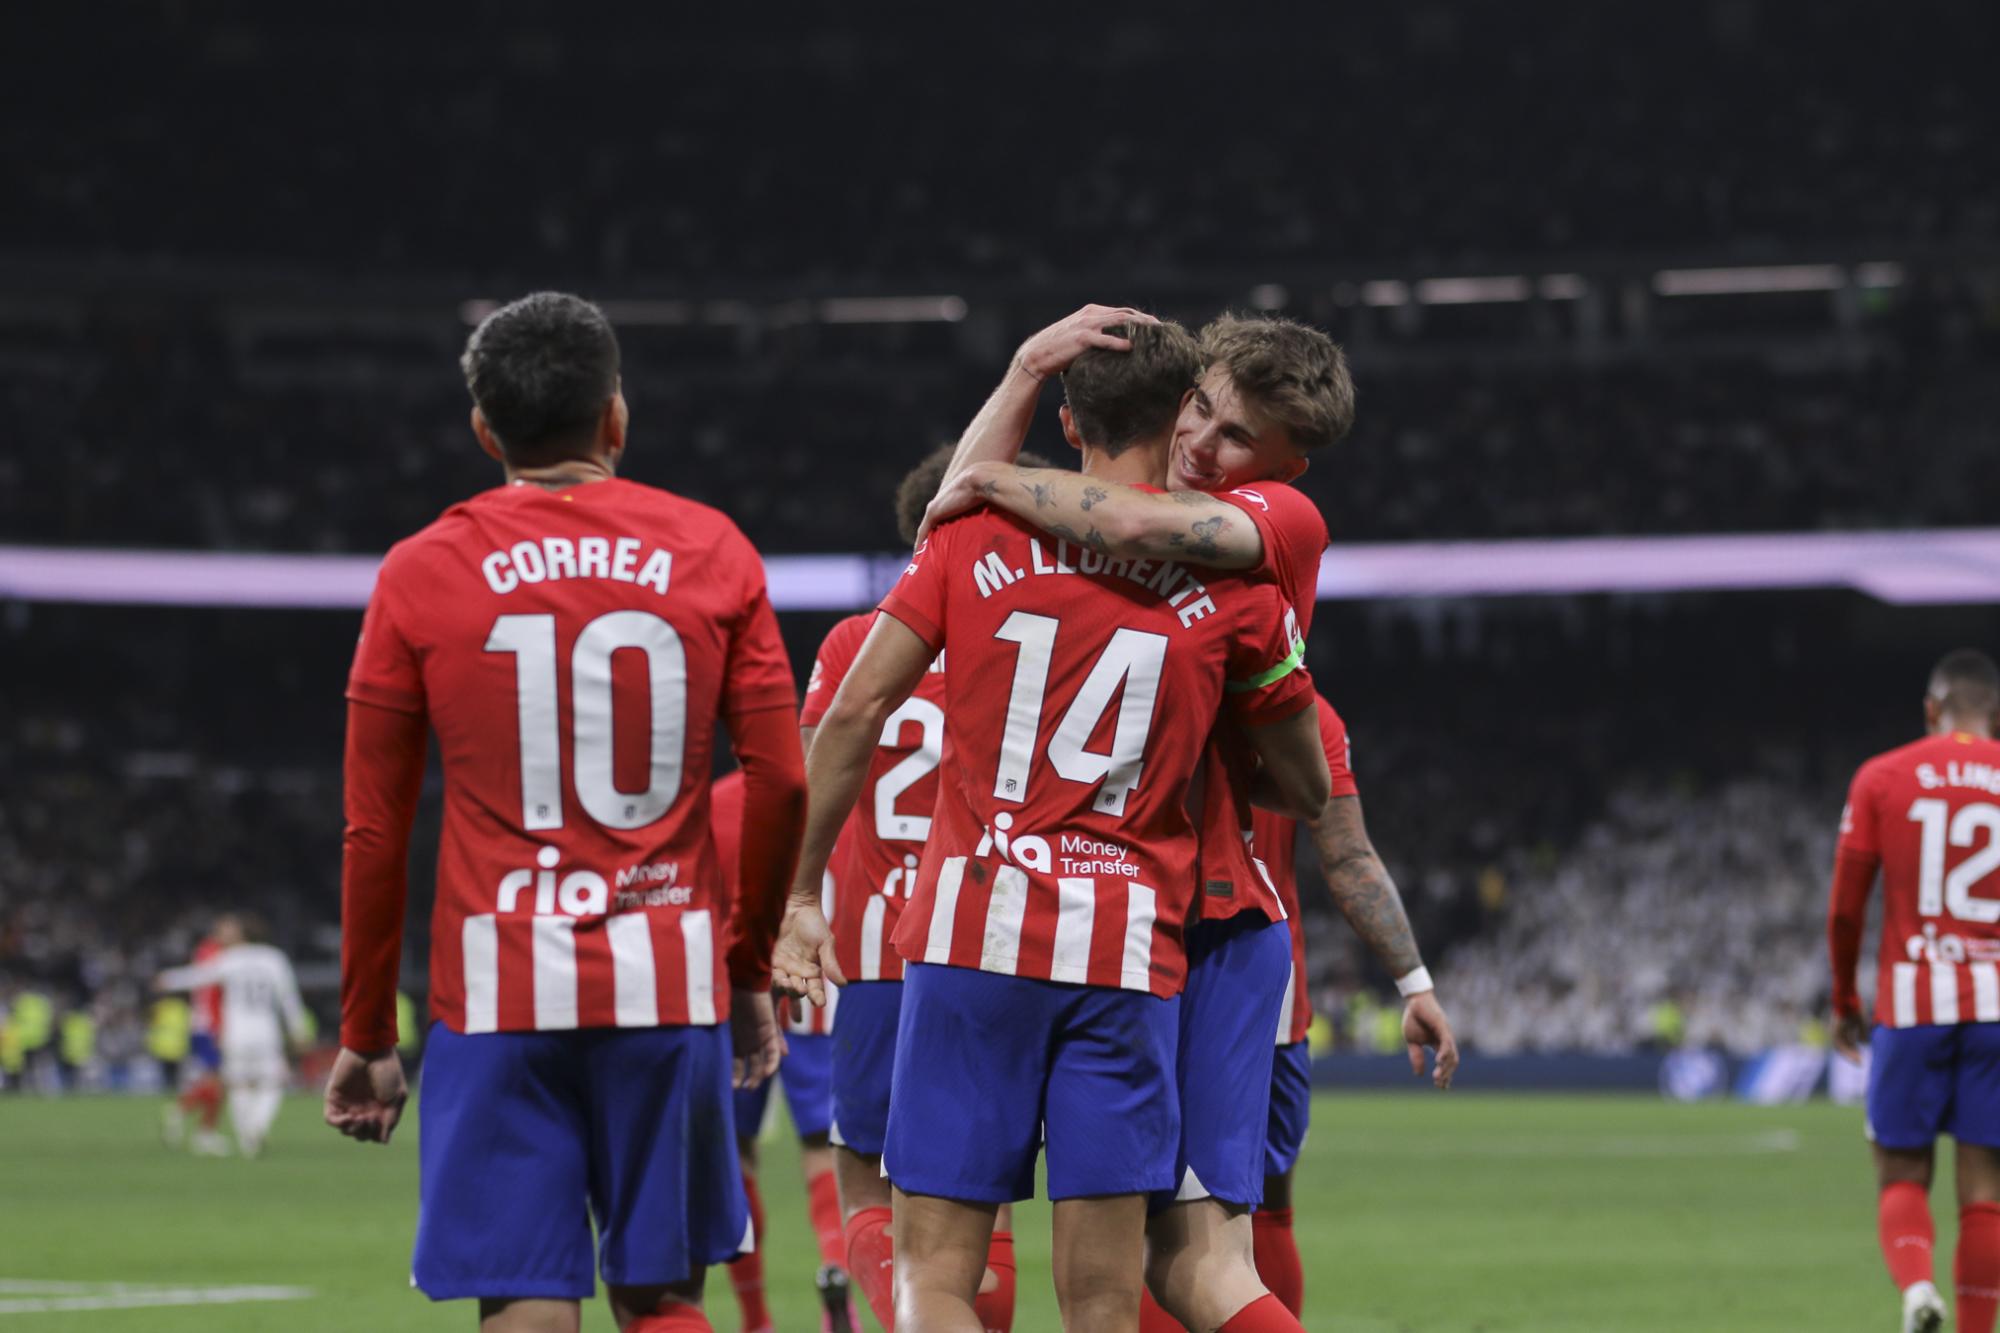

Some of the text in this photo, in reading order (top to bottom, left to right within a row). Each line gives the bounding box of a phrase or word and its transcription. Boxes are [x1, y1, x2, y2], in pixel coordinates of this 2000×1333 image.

[482, 536, 673, 595] CORREA
[973, 551, 1025, 599] M.
[484, 610, 687, 831] 10
[994, 610, 1169, 817] 14
[1060, 835, 1128, 860] Money
[1060, 857, 1140, 878] Transfer
[1906, 797, 2000, 923] 12
[497, 845, 608, 916] ria
[615, 862, 678, 888] Mney
[882, 853, 918, 900] ri
[1905, 922, 1965, 963] ria
